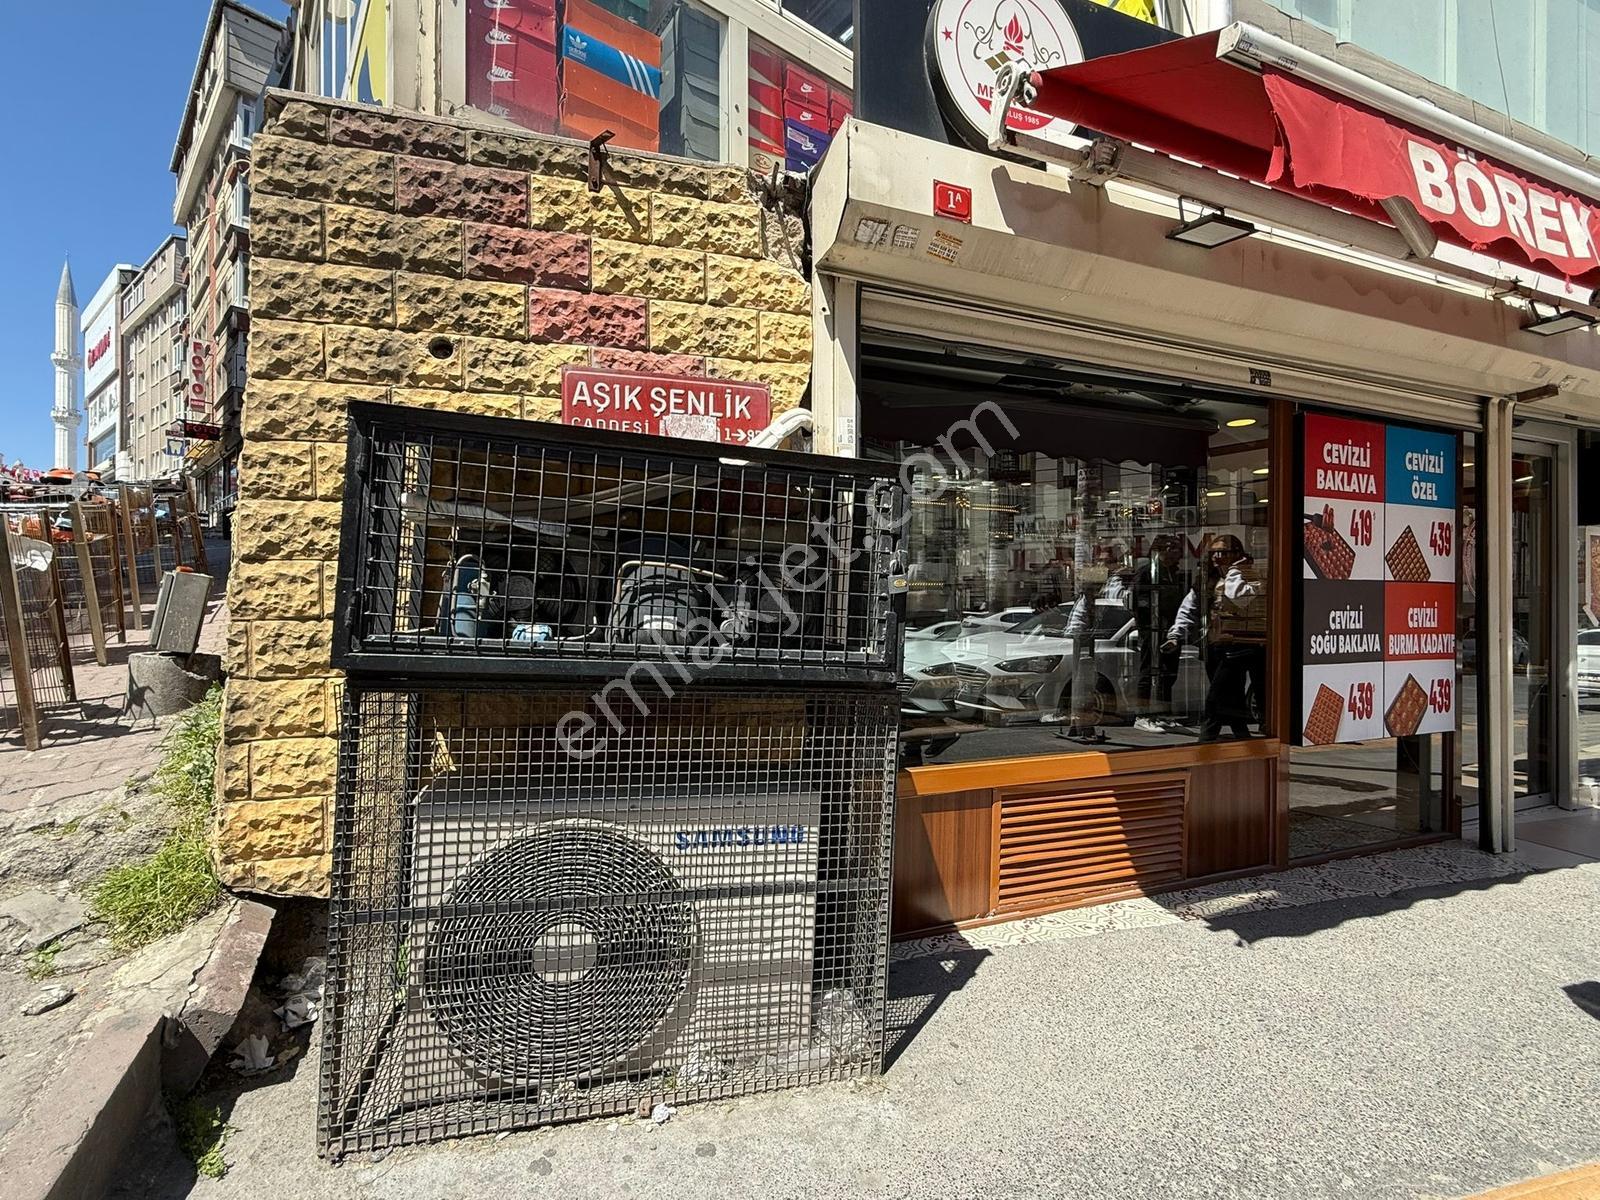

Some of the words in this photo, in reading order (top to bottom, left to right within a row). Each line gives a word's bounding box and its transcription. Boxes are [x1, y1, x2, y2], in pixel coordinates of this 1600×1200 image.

[489, 28, 512, 41] NIKE
[492, 65, 514, 79] NIKE
[488, 104, 511, 117] NIKE
[1024, 115, 1040, 125] 1985
[192, 341, 204, 395] FOTO
[571, 380, 643, 414] AŞIK
[650, 386, 752, 420] ŞENLİK
[1323, 439, 1371, 468] CEVİZLİ
[1405, 449, 1444, 474] CEVİZLİ
[1316, 468, 1377, 494] BAKLAVA
[1411, 475, 1438, 500] ÖZEL
[1329, 605, 1363, 630] CEVİZLİ
[1407, 601, 1438, 628] CEVİZLİ
[1310, 630, 1337, 655] SOĞU
[1339, 633, 1381, 653] BAKLAVA
[1388, 633, 1419, 655] BURMA
[1420, 633, 1455, 653] KADAYIF
